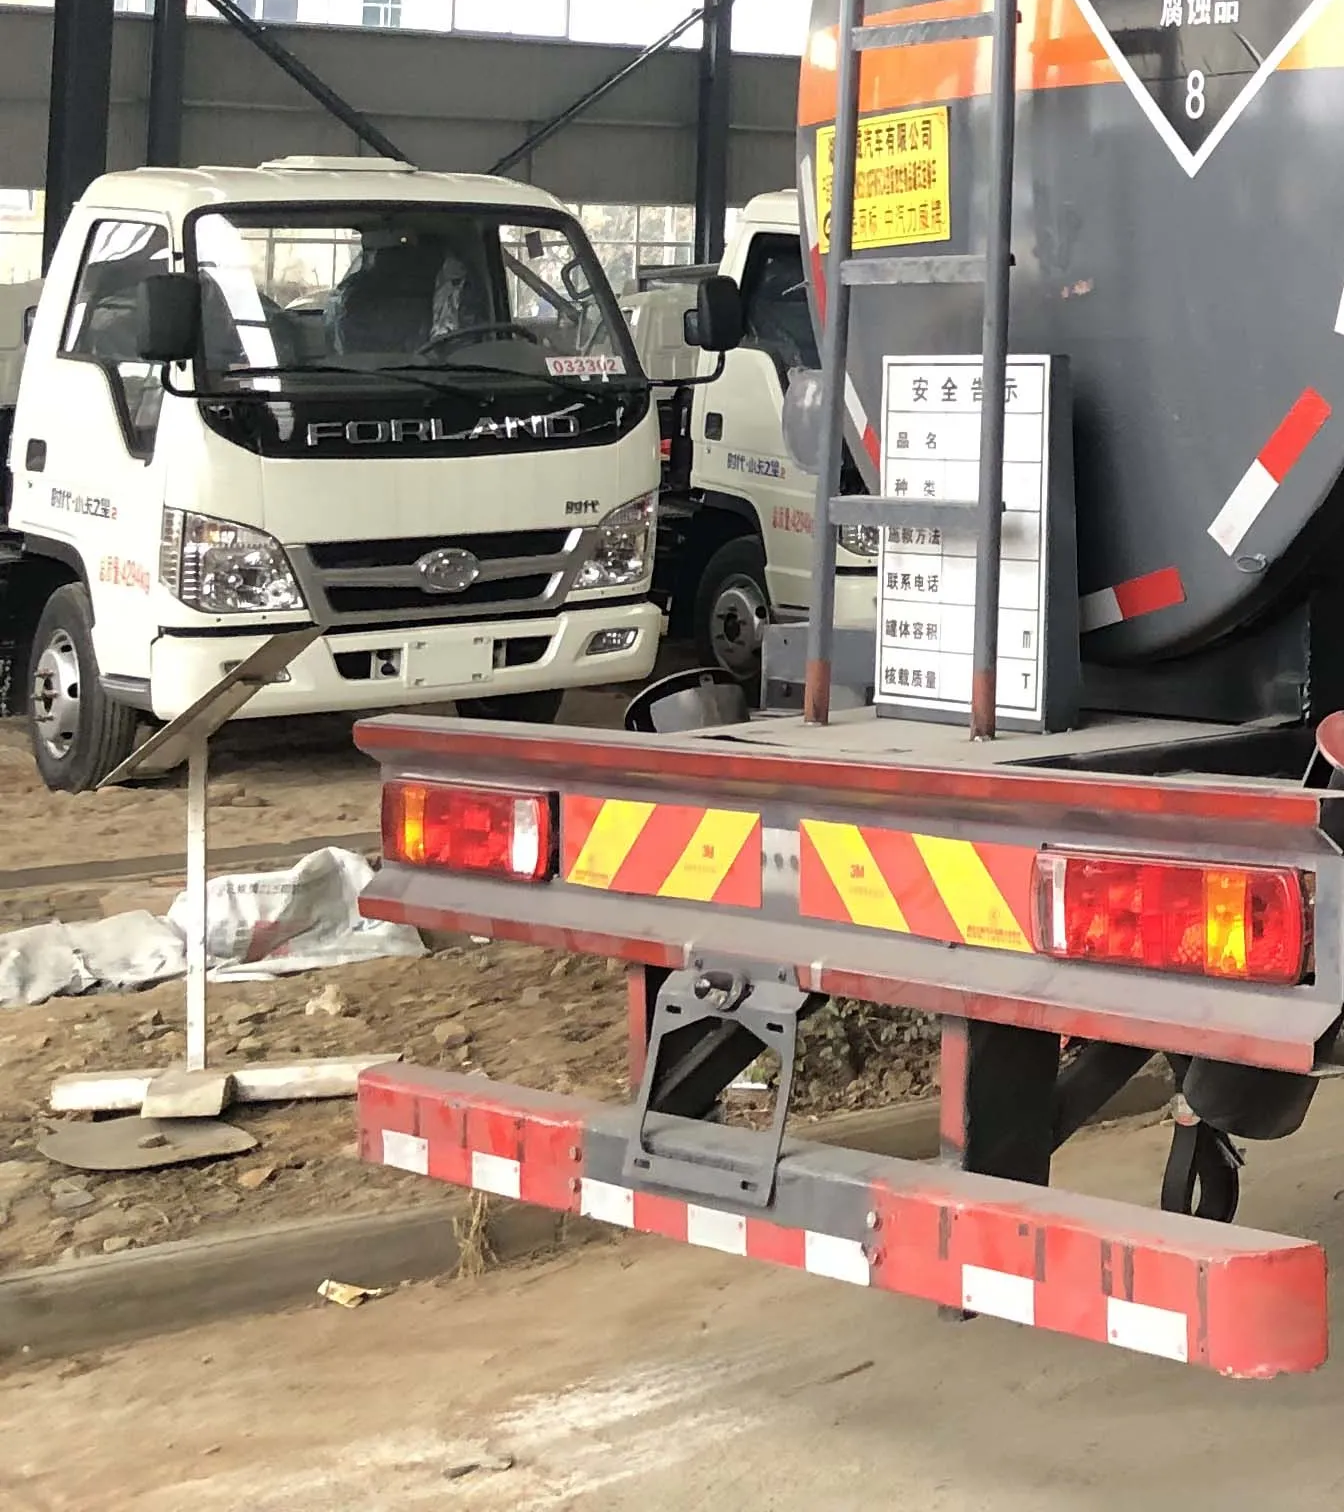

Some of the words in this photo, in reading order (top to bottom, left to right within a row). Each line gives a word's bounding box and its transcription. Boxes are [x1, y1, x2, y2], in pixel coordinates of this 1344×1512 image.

[1185, 69, 1205, 120] 8
[306, 414, 581, 447] FORLAND
[886, 572, 939, 592] 联系电话
[850, 864, 865, 879] 3M
